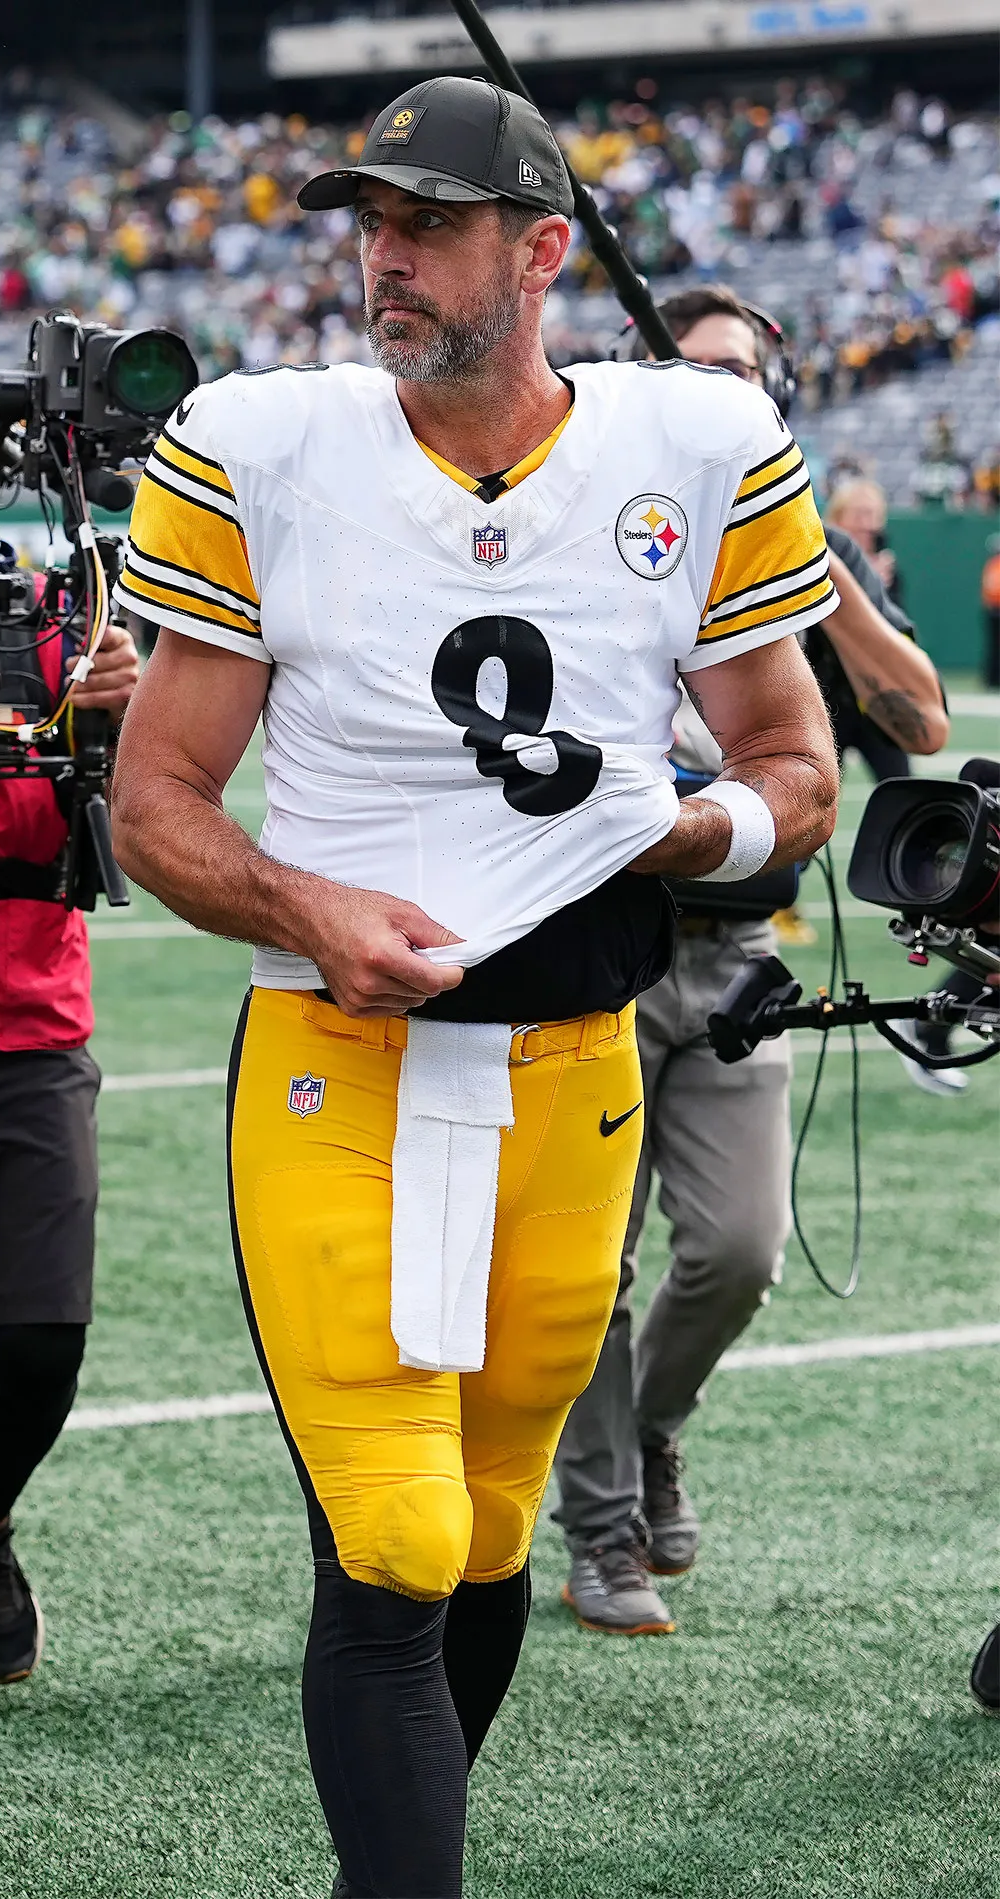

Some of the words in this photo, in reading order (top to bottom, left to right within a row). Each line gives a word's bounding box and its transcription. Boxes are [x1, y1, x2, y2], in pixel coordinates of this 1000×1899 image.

[623, 529, 653, 540] Steelers
[477, 542, 504, 560] NFL
[431, 614, 603, 817] 8
[292, 1092, 317, 1109] NFL
